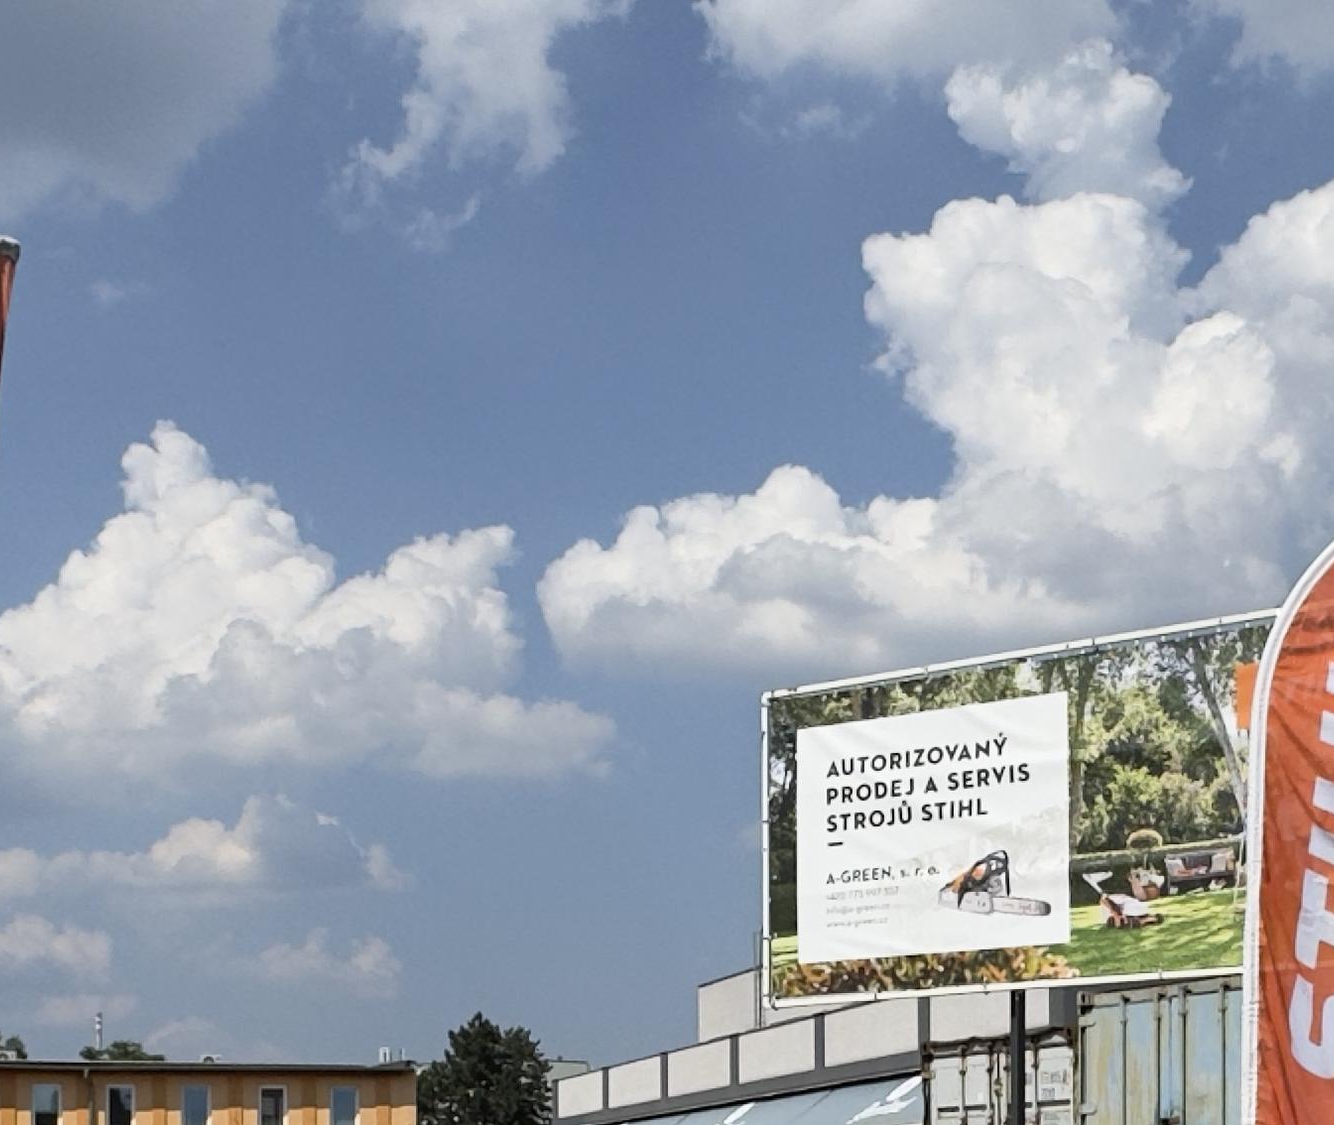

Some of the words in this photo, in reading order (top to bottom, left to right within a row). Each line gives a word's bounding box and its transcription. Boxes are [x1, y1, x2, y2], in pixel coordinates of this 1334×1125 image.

[826, 732, 1008, 779] AUTORIZOVANÝ
[826, 778, 915, 805] PRODEJ
[924, 776, 939, 794] A
[947, 763, 1031, 791] SERVIS
[826, 800, 913, 833] STROJŮ
[921, 798, 989, 822] STIHL
